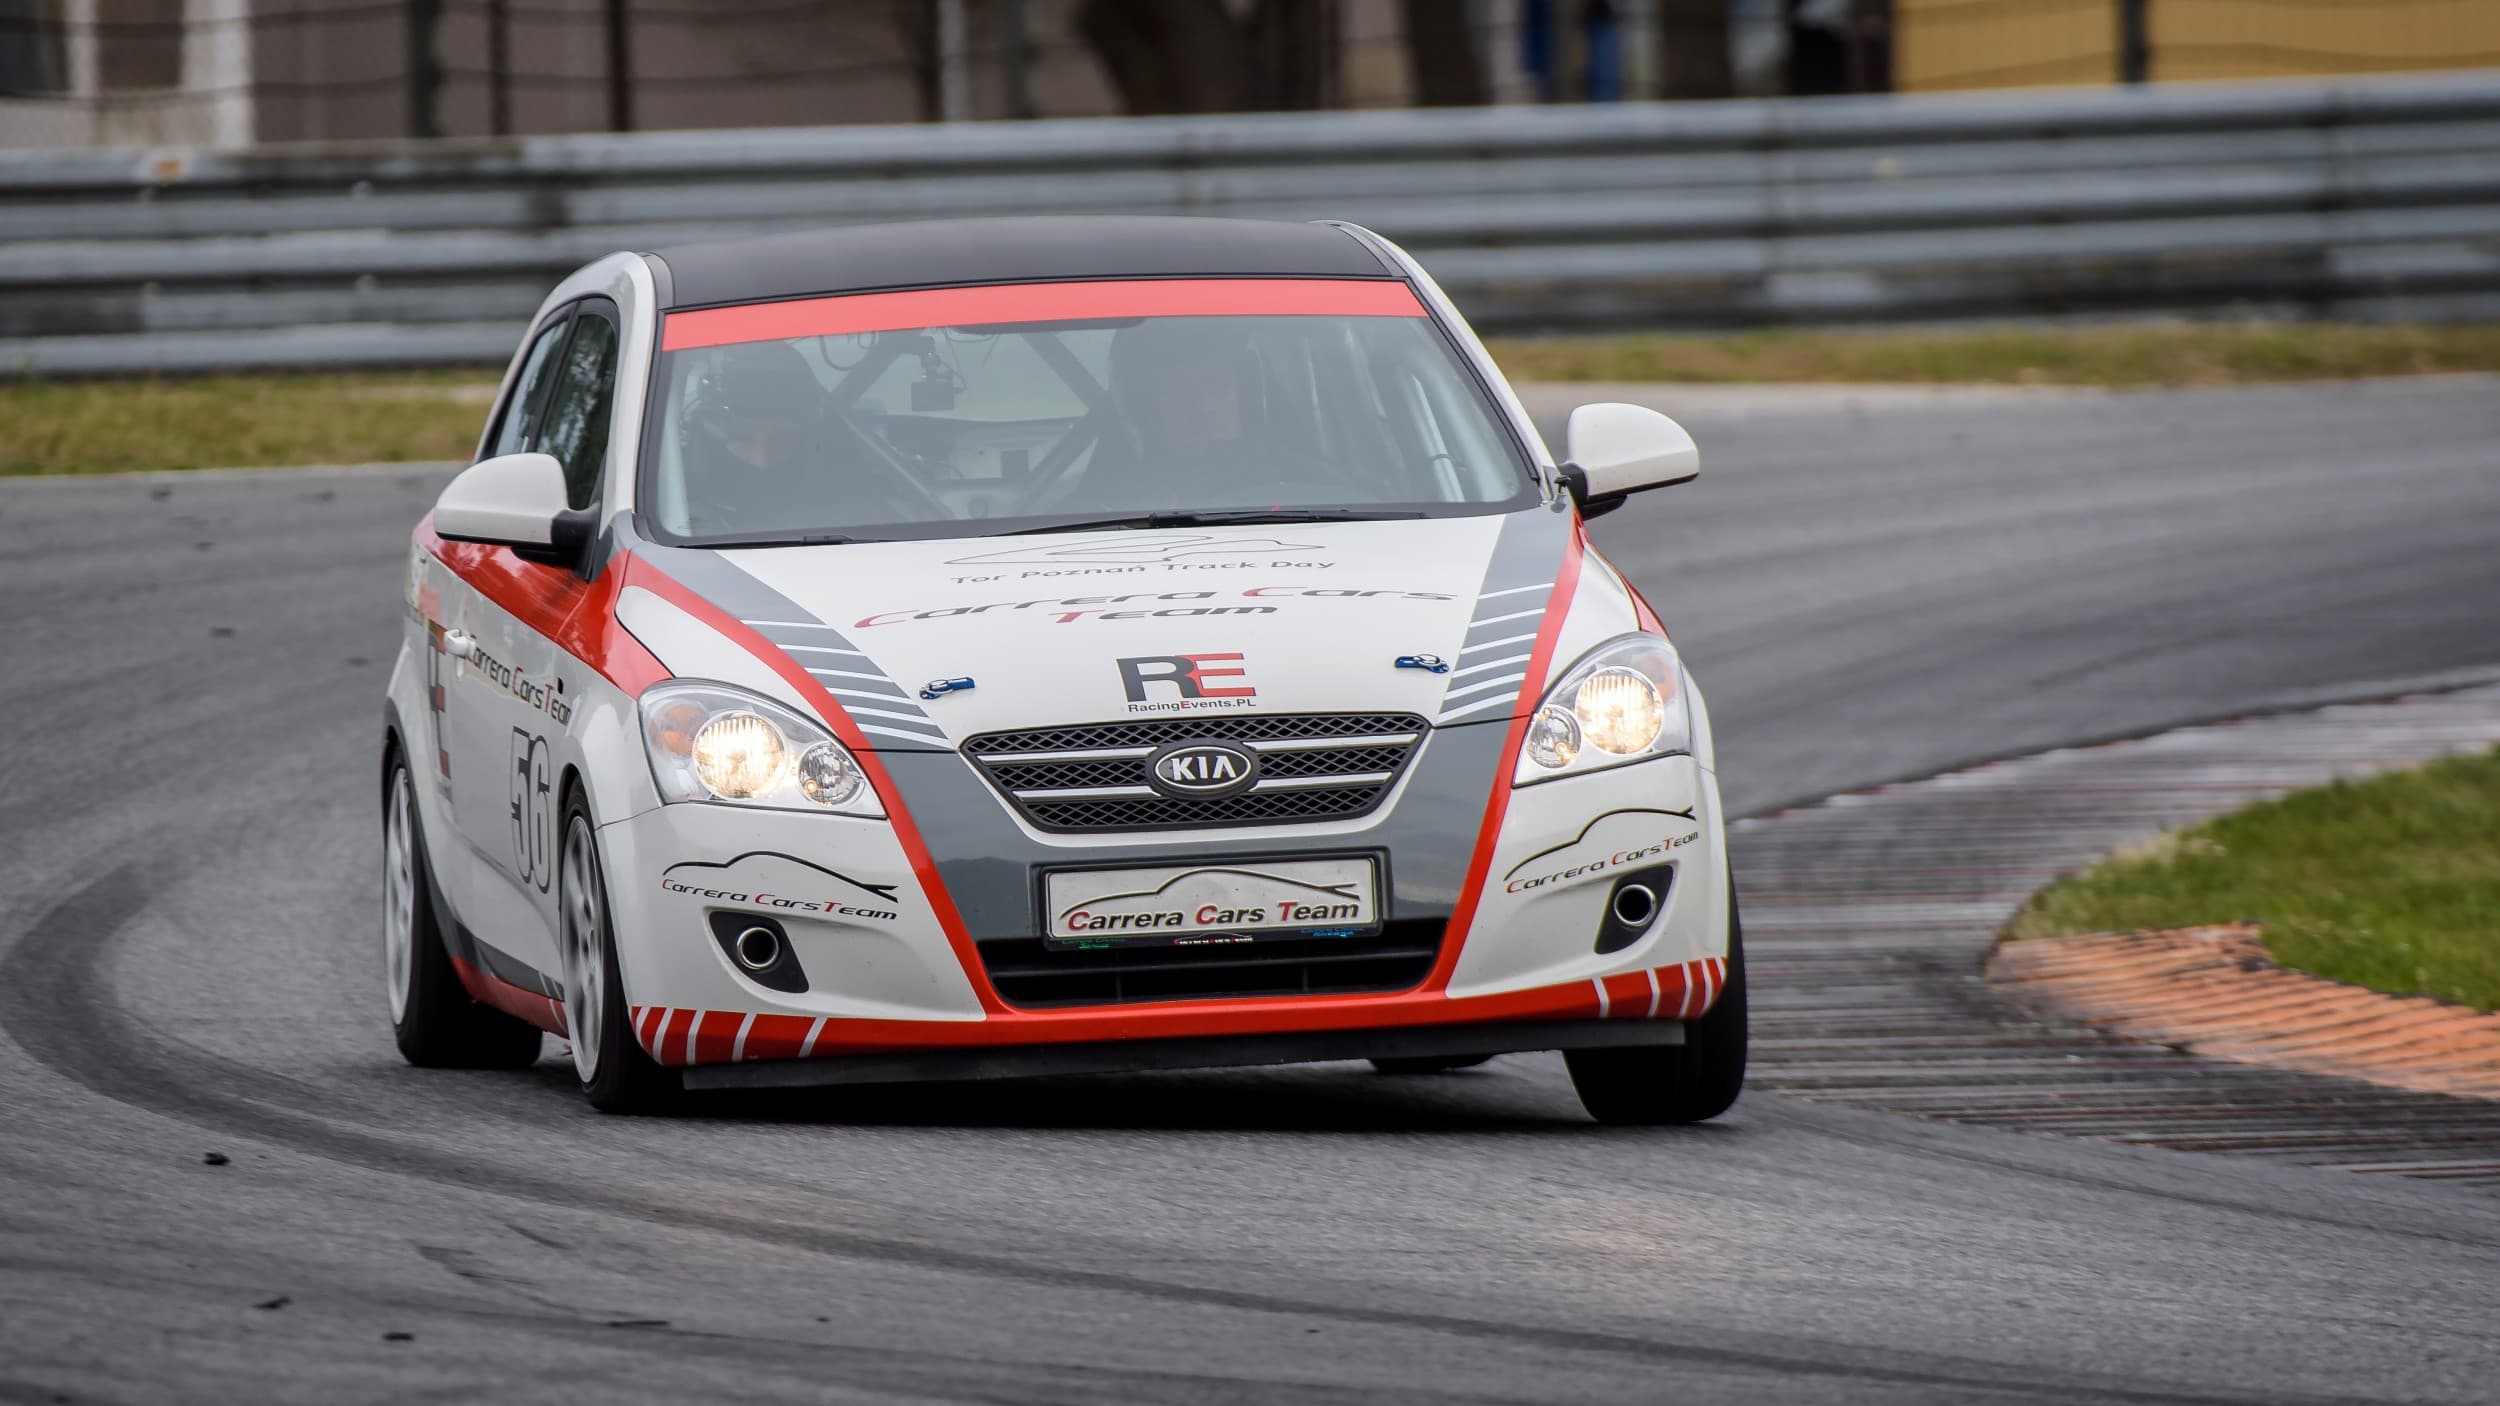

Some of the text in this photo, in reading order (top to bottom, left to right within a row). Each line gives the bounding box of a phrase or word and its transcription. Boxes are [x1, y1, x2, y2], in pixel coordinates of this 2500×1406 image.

[951, 561, 1336, 585] Tor Poznań Track Day
[854, 586, 1459, 629] Carrera Cars
[1047, 606, 1278, 624] Team
[1116, 652, 1257, 702] RE
[1127, 699, 1257, 713] RacingEvents.PL
[1170, 755, 1238, 782] KIA
[511, 725, 552, 894] 56
[662, 878, 748, 902] Carrera
[1506, 859, 1605, 895] Carrera
[1067, 900, 1360, 931] Carrera Cars Team
